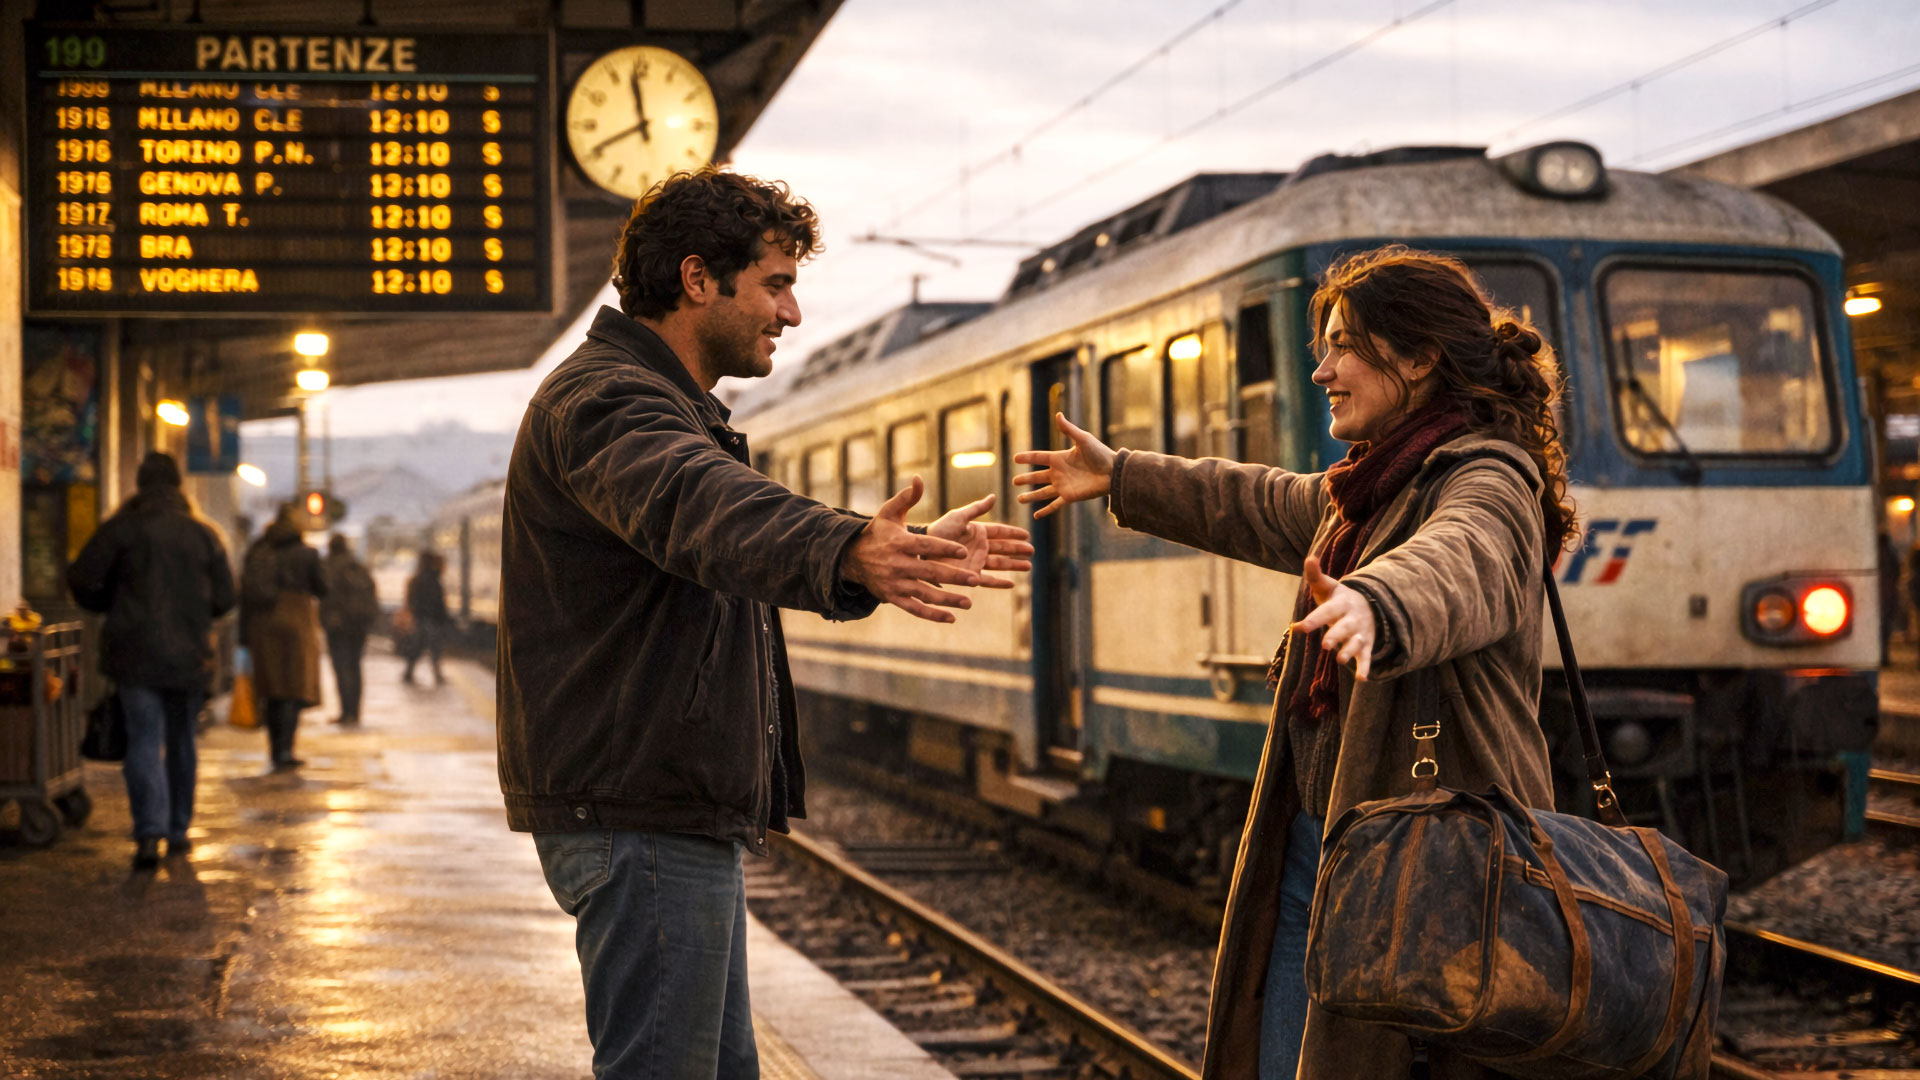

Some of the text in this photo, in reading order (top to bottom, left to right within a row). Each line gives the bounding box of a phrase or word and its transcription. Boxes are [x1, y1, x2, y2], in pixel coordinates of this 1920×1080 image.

[198, 38, 415, 72] PARTENZE
[138, 107, 240, 131] MILANO
[254, 109, 300, 131] CLE
[370, 109, 450, 134] 12:10
[482, 110, 501, 133] S
[139, 139, 241, 164] TORINO
[254, 141, 313, 164] P.N.
[370, 141, 450, 167] 12:10
[482, 142, 502, 165] S
[139, 171, 242, 195] GENOVA
[255, 172, 281, 195] P.
[483, 174, 503, 197] S
[139, 202, 209, 226] ROMA
[222, 203, 248, 226] T.
[371, 205, 451, 229] 12:10
[483, 205, 503, 229] S
[140, 235, 193, 259] BRA
[371, 237, 452, 262] 12:10
[484, 238, 503, 261] S
[139, 268, 259, 292] VOGHERA
[372, 269, 452, 294] 12:10
[485, 270, 504, 293] S
